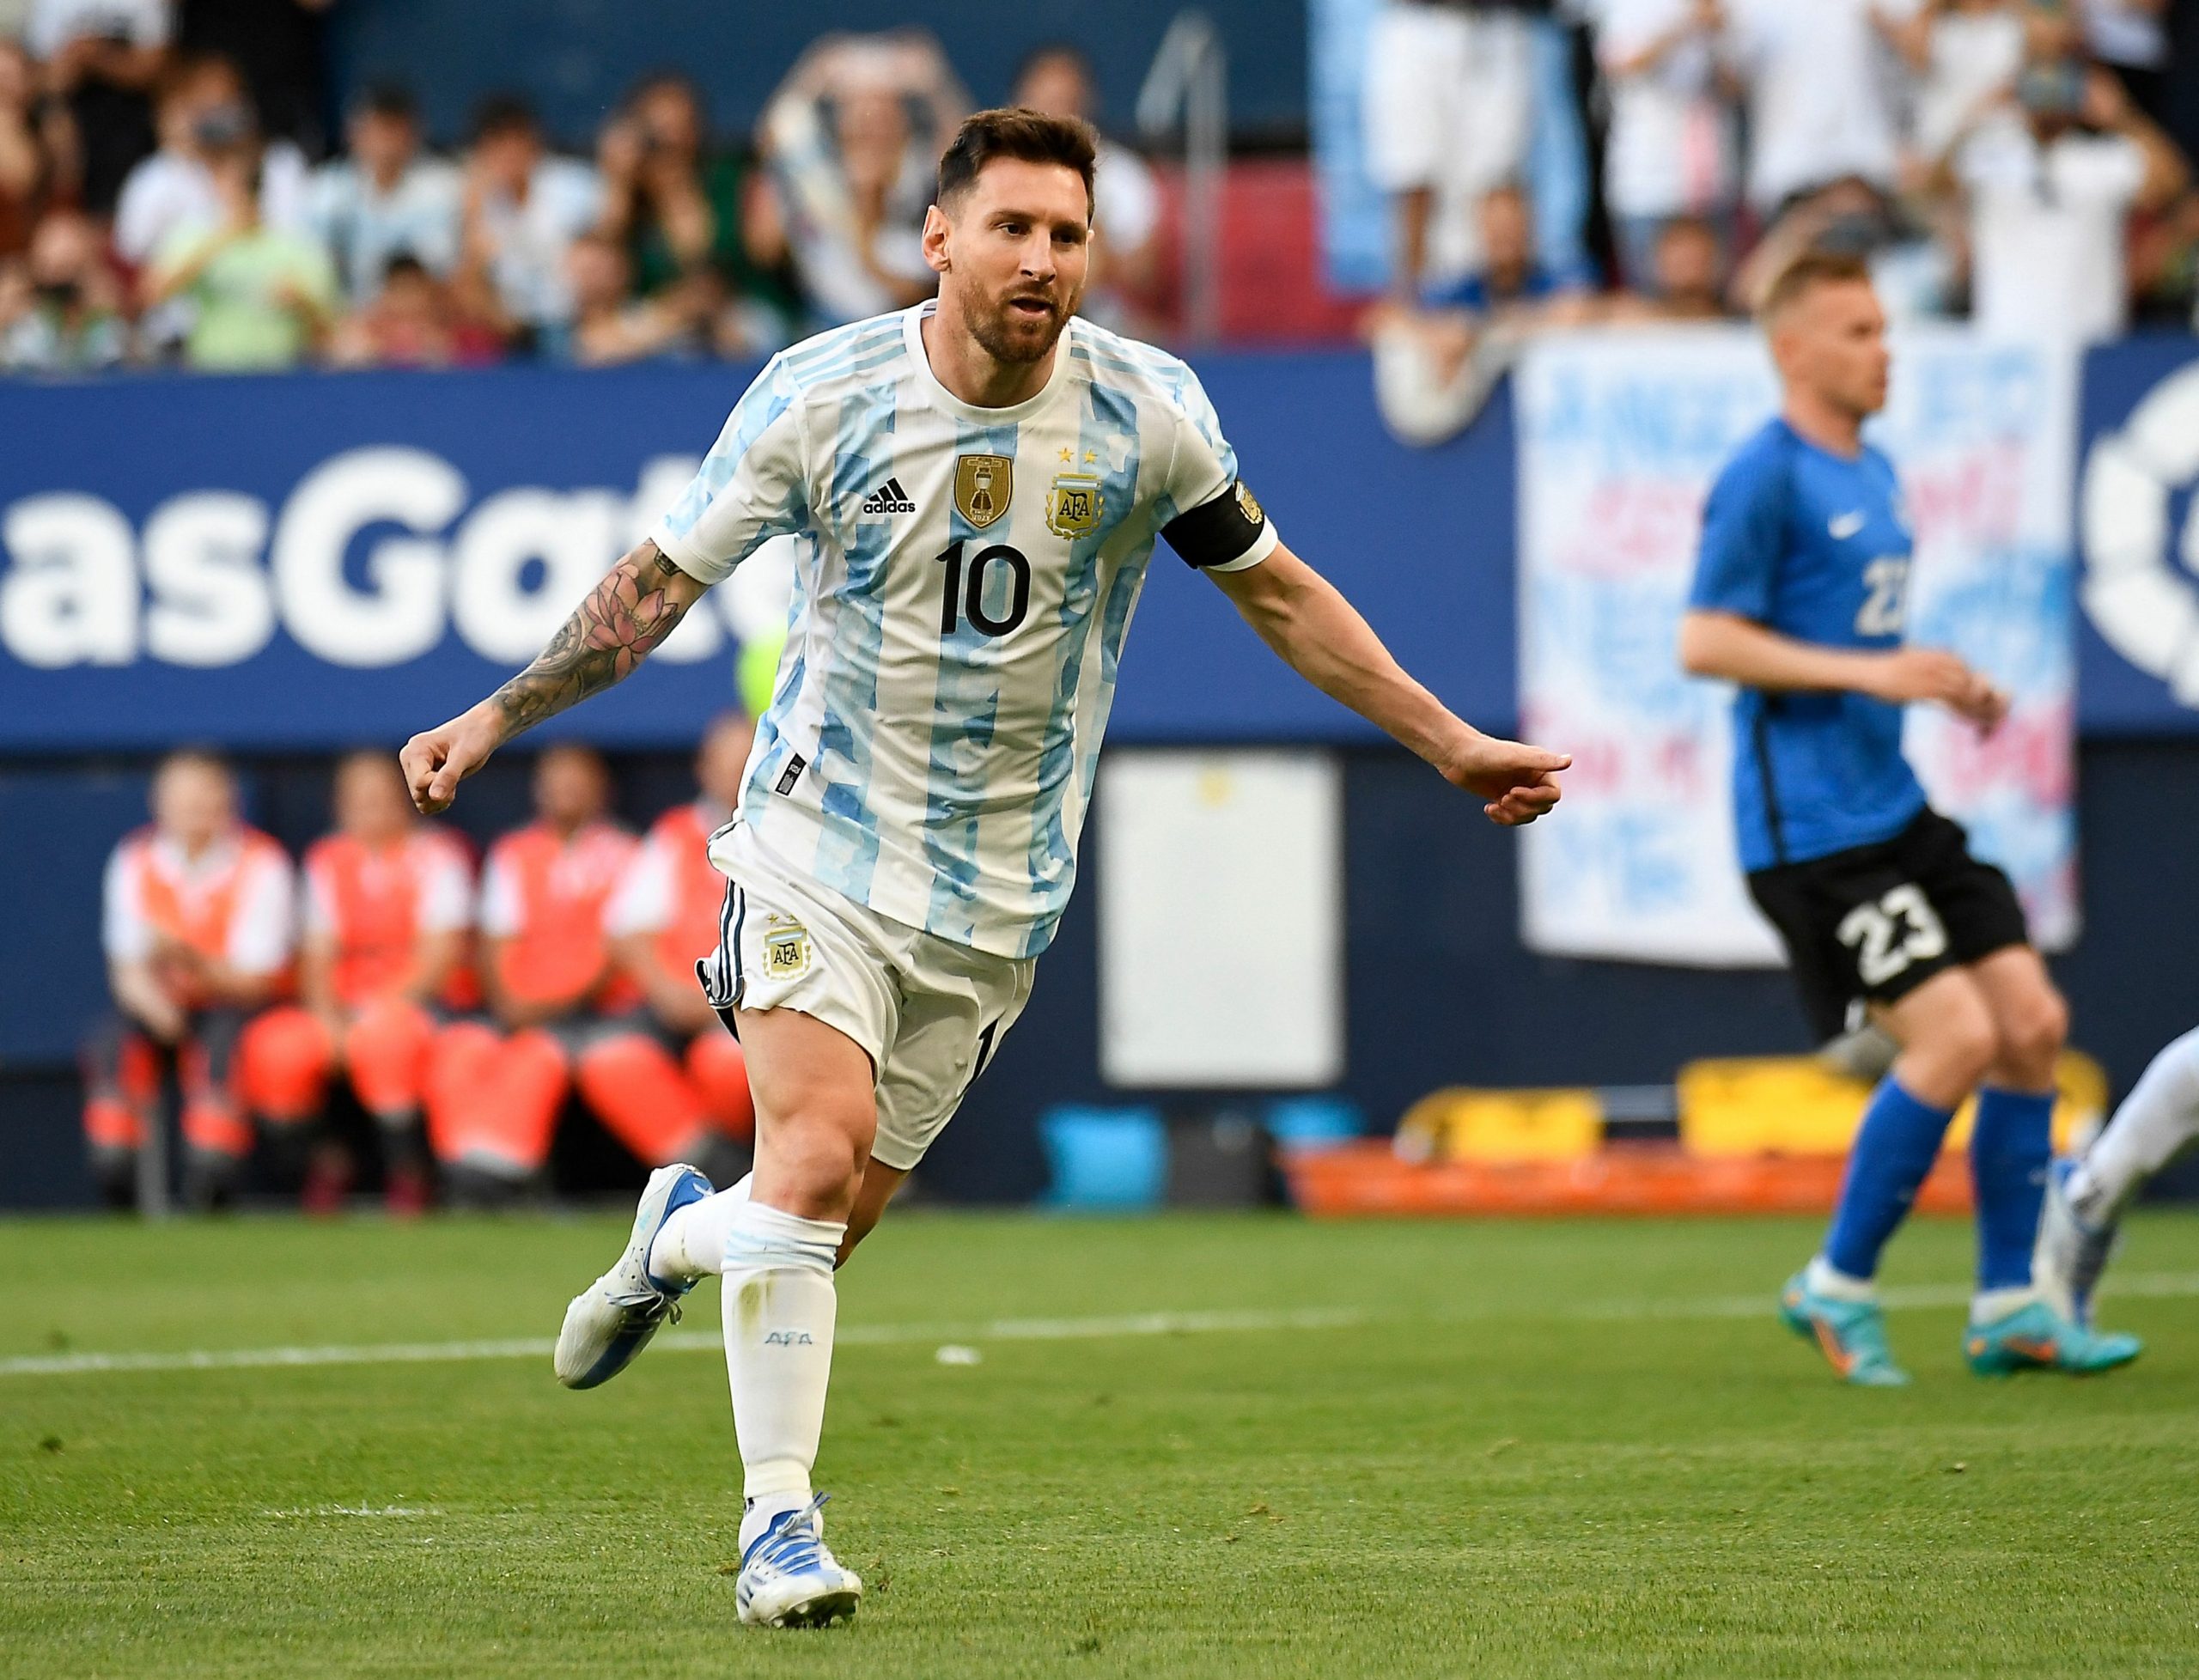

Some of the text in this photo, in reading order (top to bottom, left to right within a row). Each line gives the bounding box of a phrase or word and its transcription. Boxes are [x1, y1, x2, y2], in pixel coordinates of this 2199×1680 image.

[862, 498, 917, 514] adidas
[1059, 490, 1091, 521] AFA
[935, 539, 1031, 637] 10
[1837, 884, 1947, 986] 23
[773, 941, 800, 965] AFA
[764, 1331, 813, 1347] AFA
